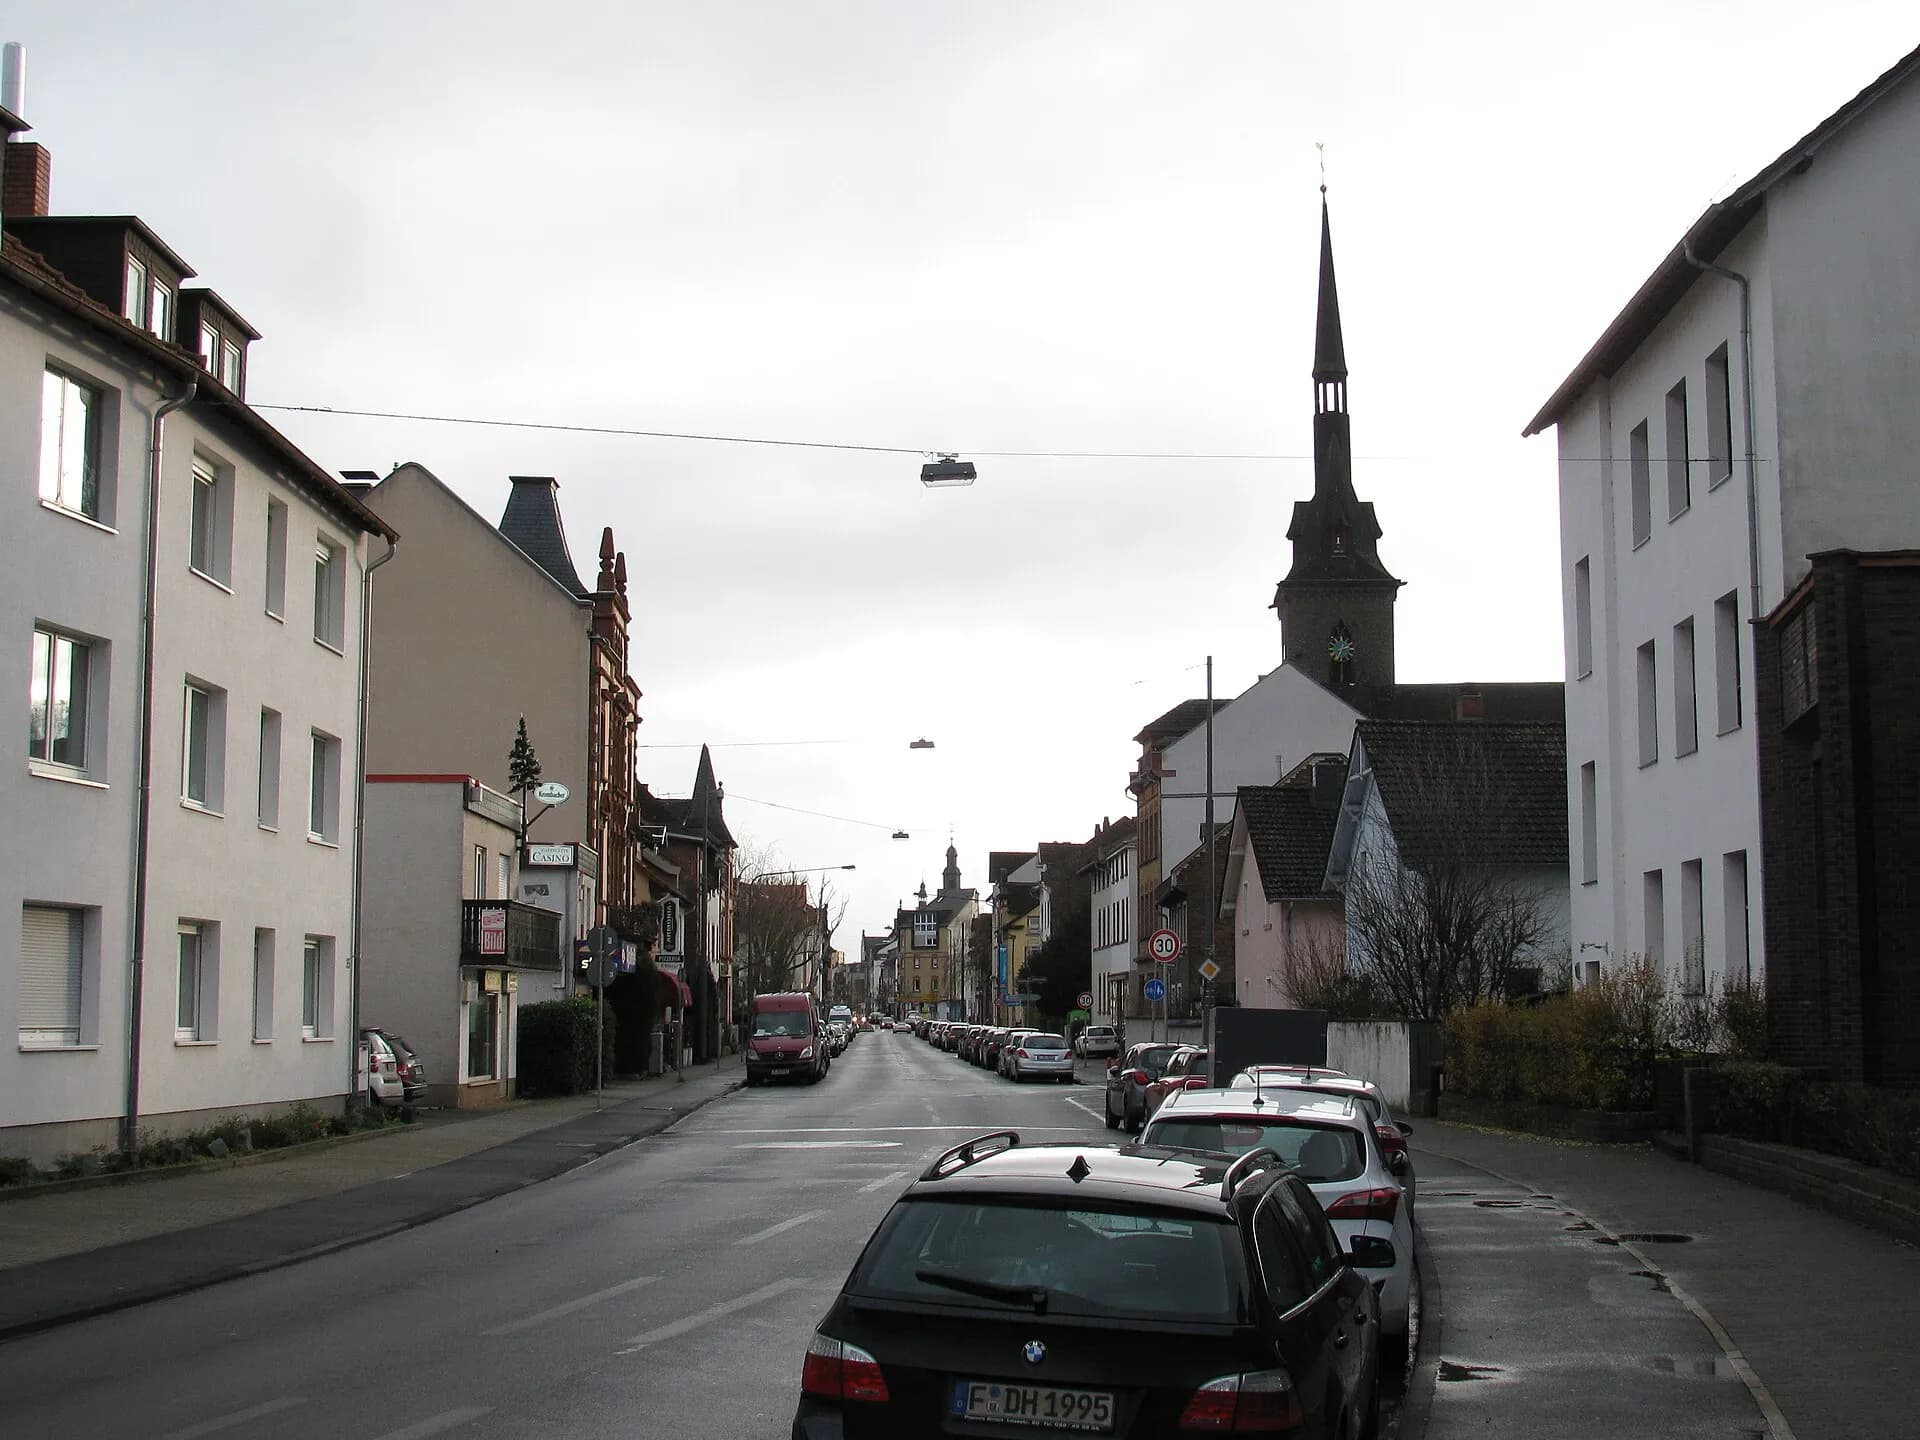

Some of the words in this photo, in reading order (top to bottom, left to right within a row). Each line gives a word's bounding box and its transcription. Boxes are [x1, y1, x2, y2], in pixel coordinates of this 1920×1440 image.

[533, 852, 570, 862] CASINO
[484, 931, 503, 951] Bild
[1156, 939, 1173, 953] 30
[969, 1386, 987, 1410] F
[1004, 1387, 1038, 1415] DH
[1044, 1391, 1110, 1422] 1995
